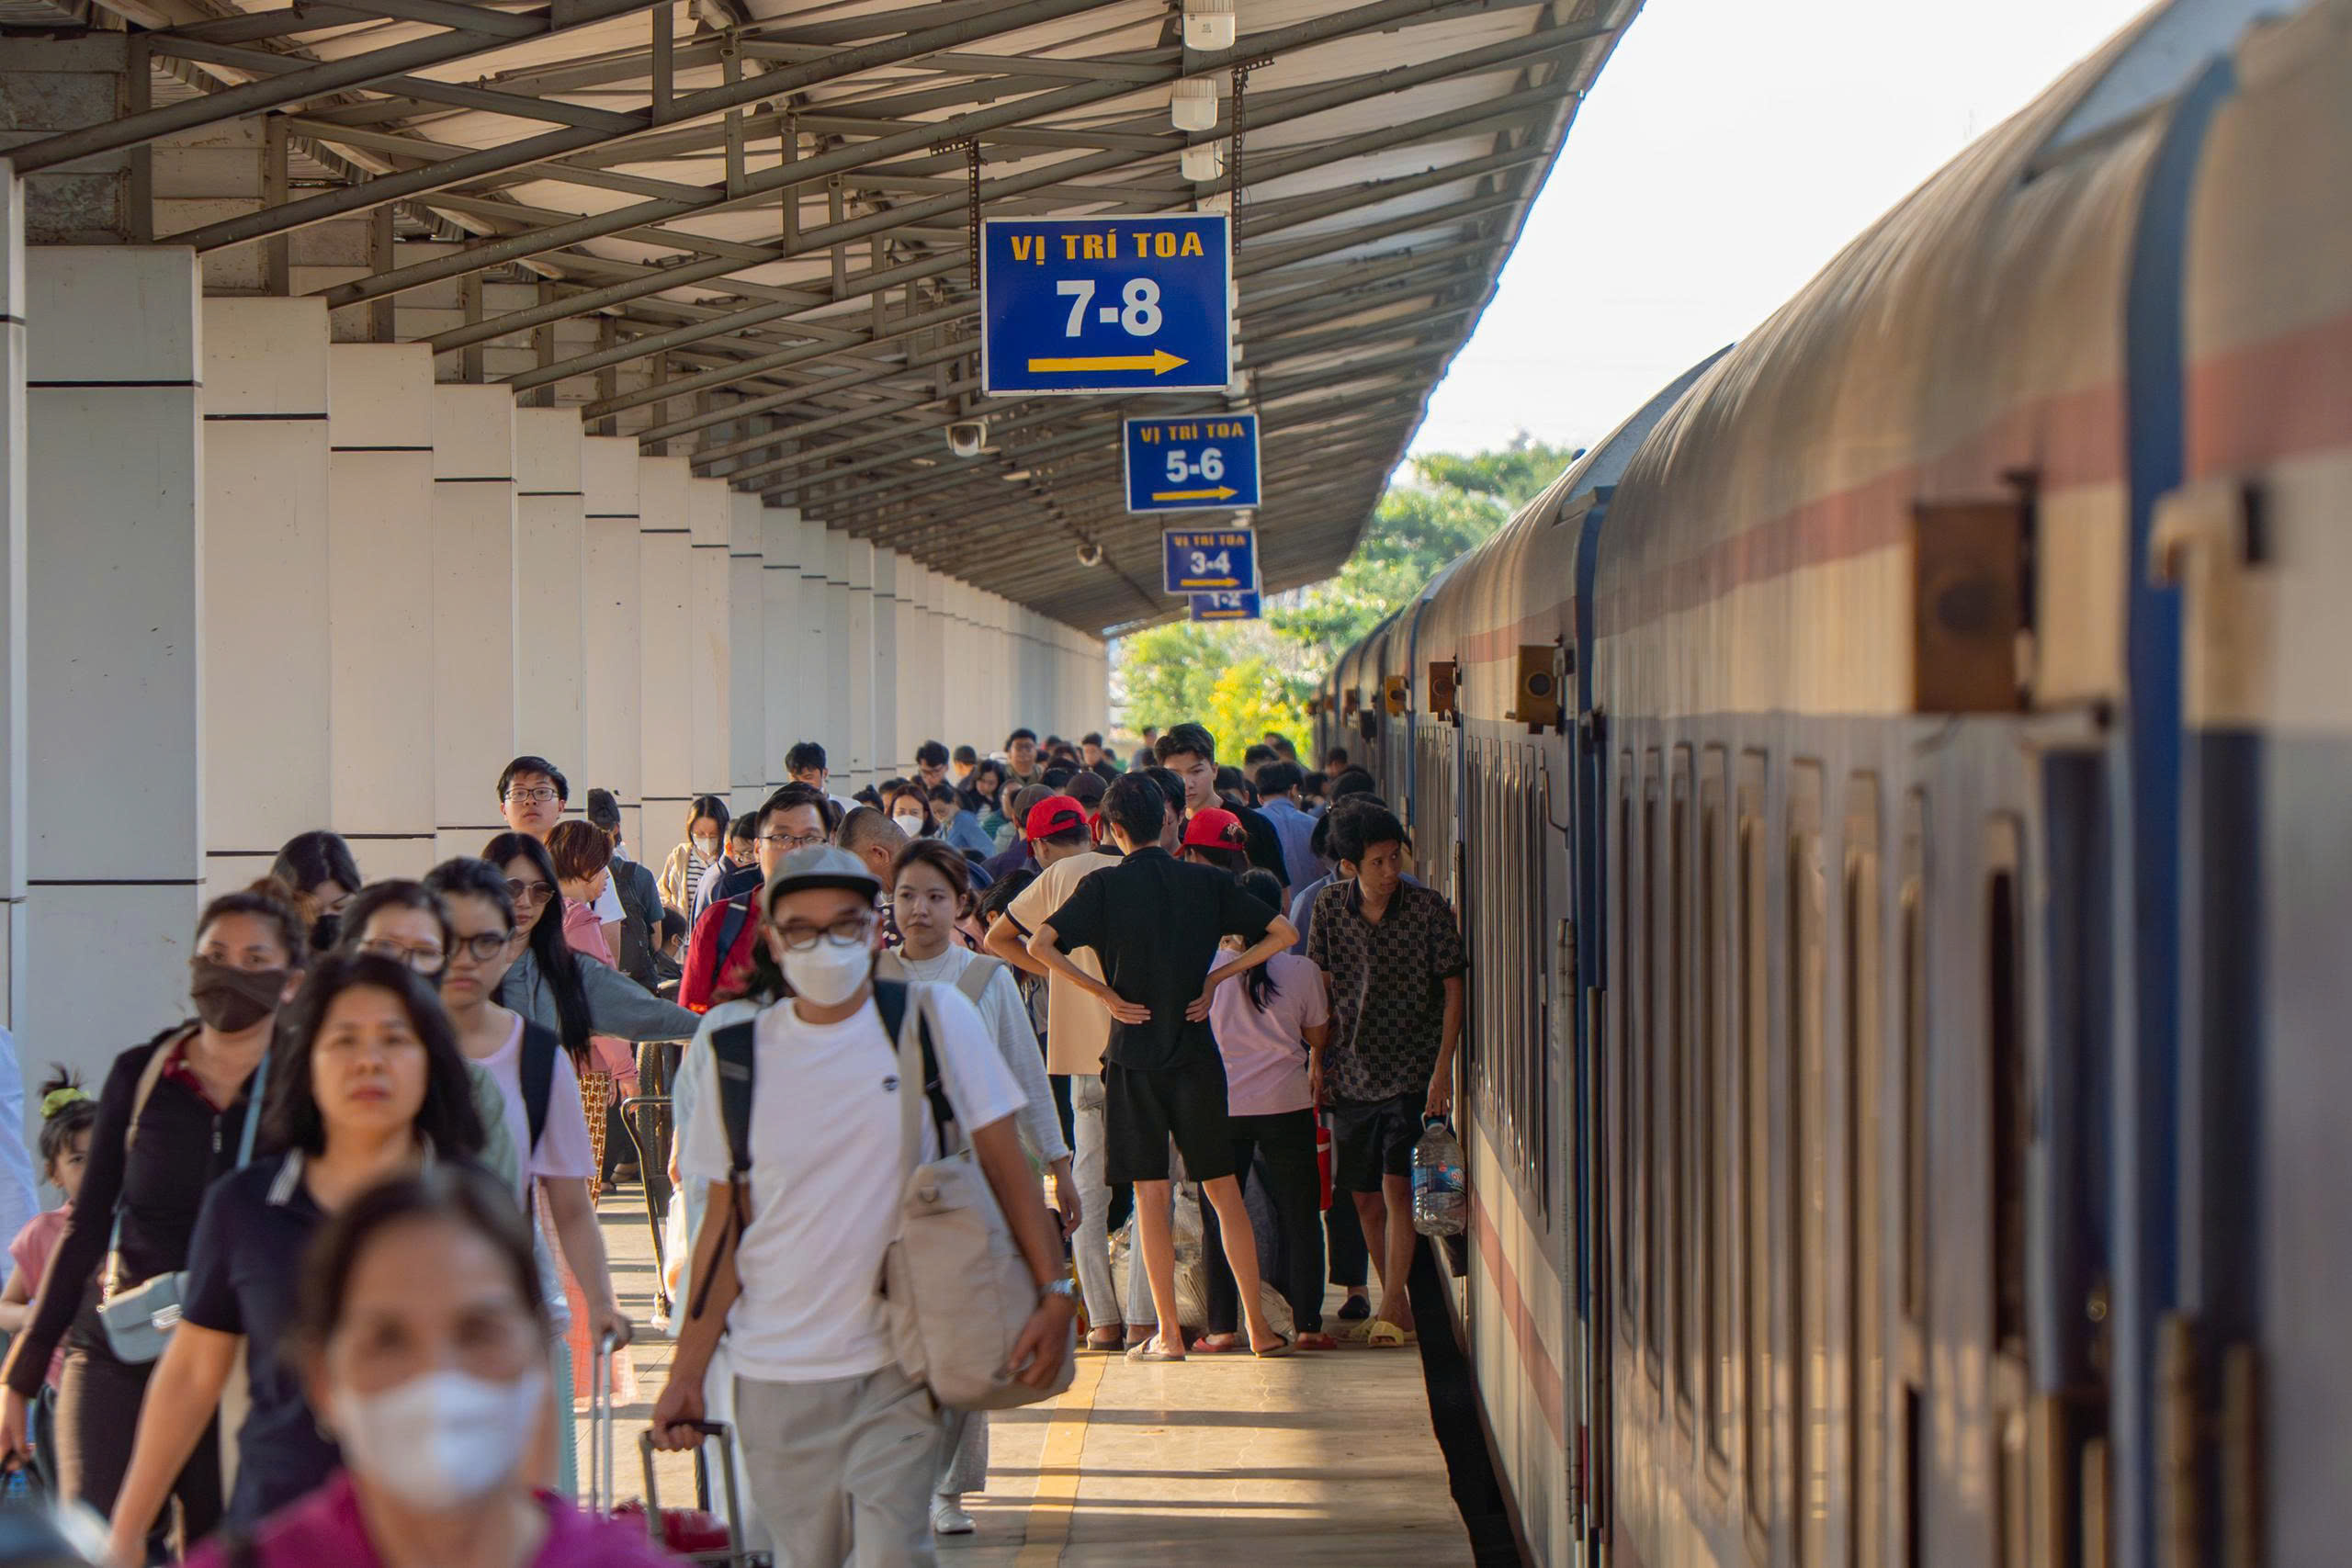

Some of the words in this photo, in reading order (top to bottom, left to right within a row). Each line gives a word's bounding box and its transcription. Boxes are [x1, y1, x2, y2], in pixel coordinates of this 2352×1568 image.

[1011, 235, 1046, 265] VỊ
[1061, 229, 1117, 260] TRÍ
[1133, 231, 1204, 258] TOA
[1057, 277, 1162, 338] 7-8
[1140, 426, 1160, 445] VỊ
[1205, 423, 1245, 438] TOA
[1166, 447, 1225, 483] 5-6
[1191, 550, 1231, 575] 3-4
